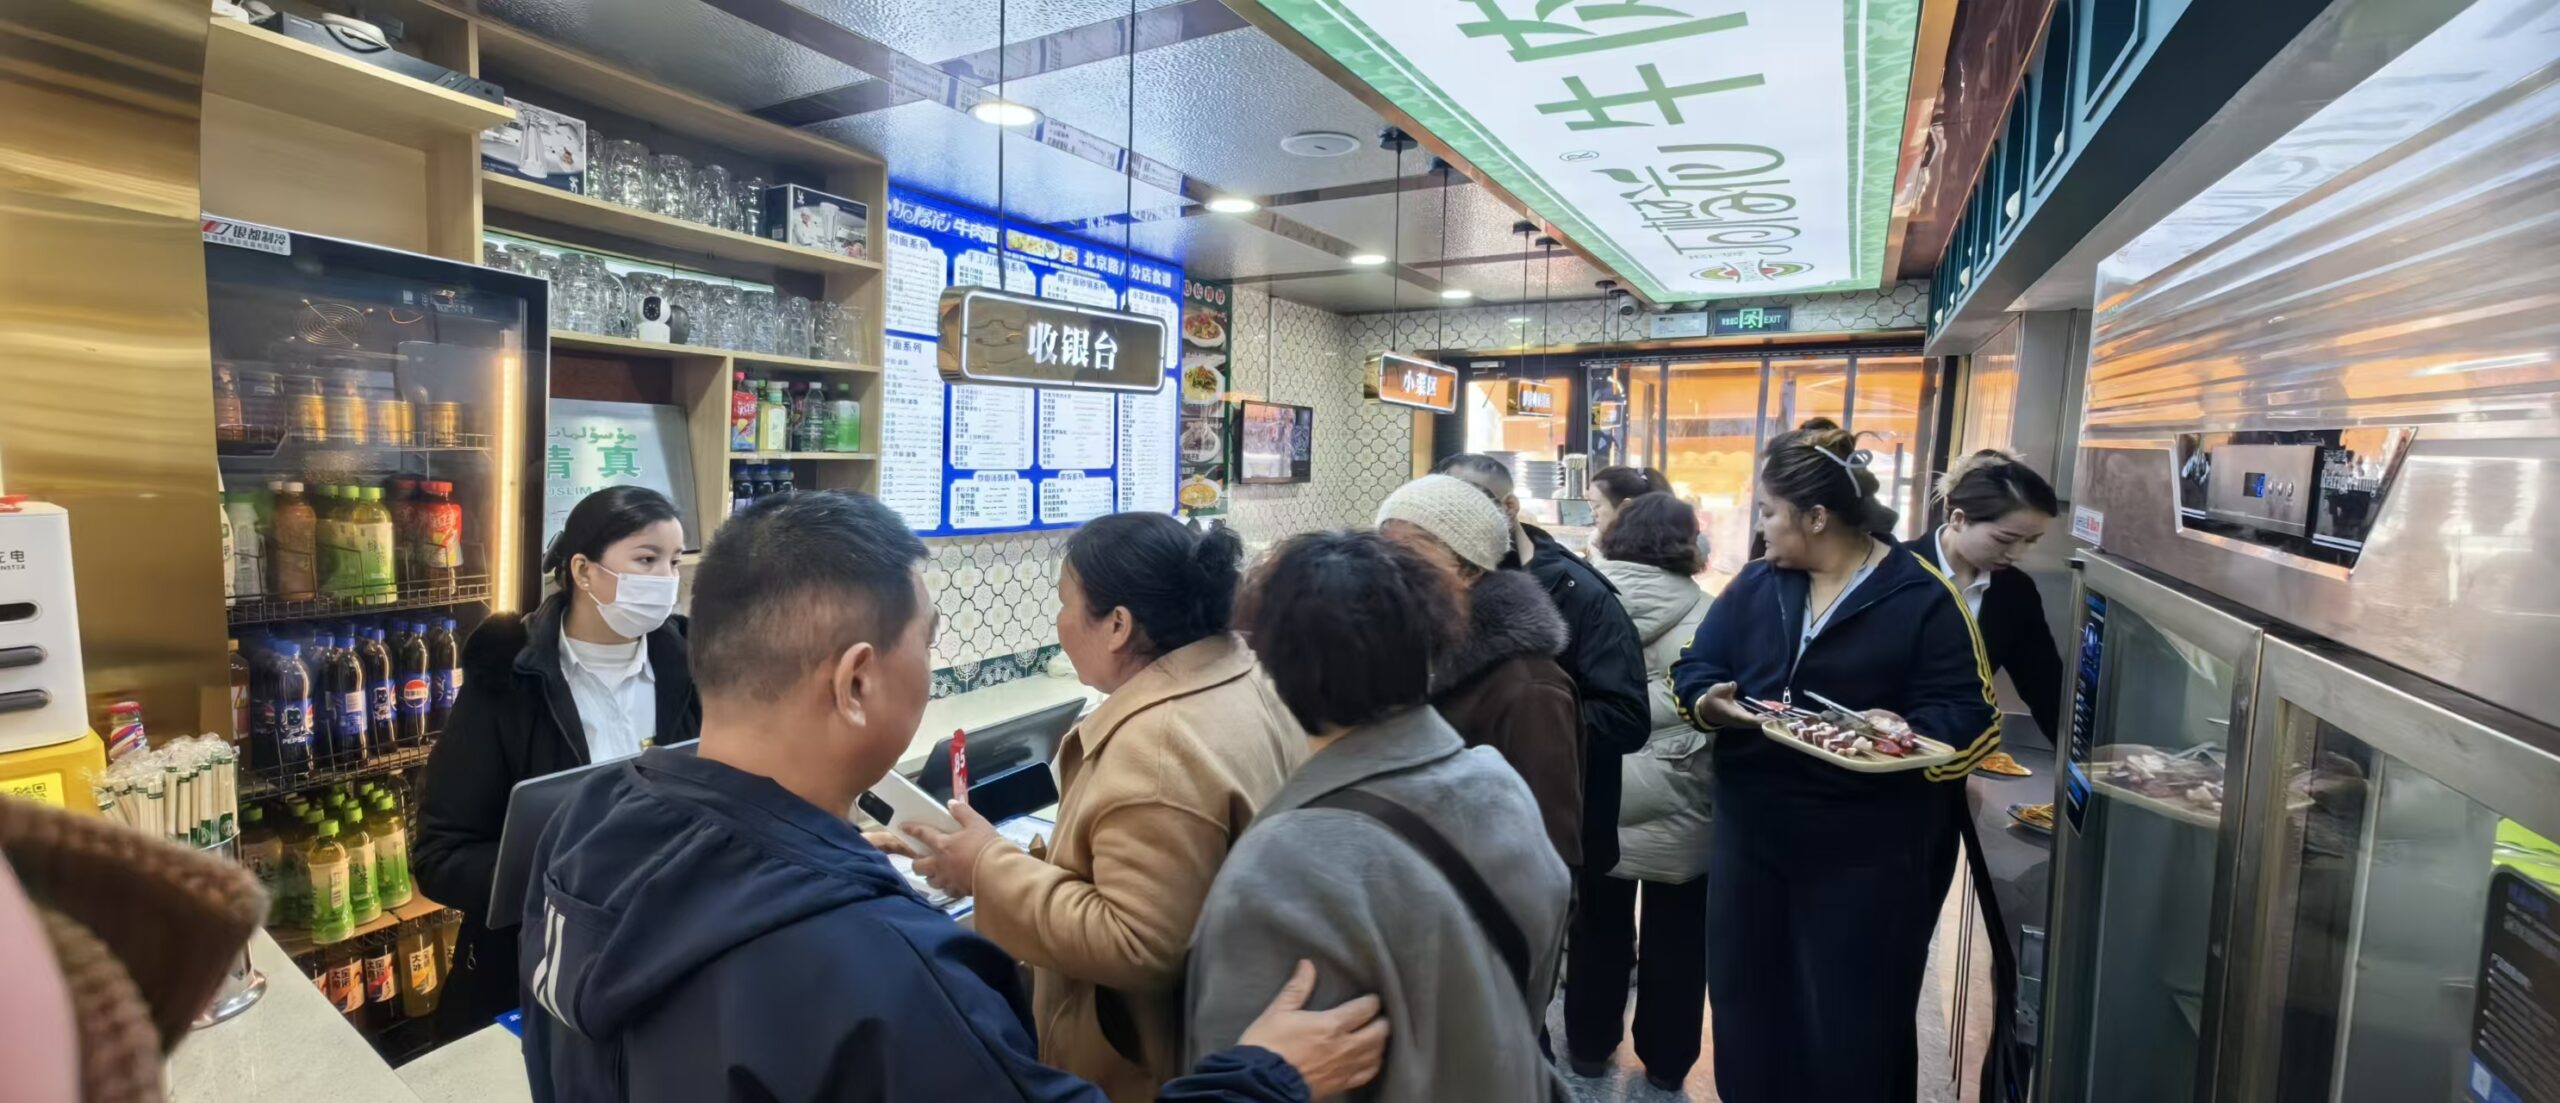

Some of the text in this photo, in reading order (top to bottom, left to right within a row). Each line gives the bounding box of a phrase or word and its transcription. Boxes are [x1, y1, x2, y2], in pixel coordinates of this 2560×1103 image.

[1763, 315, 1781, 324] EXIT
[1027, 321, 1118, 370] 收银台
